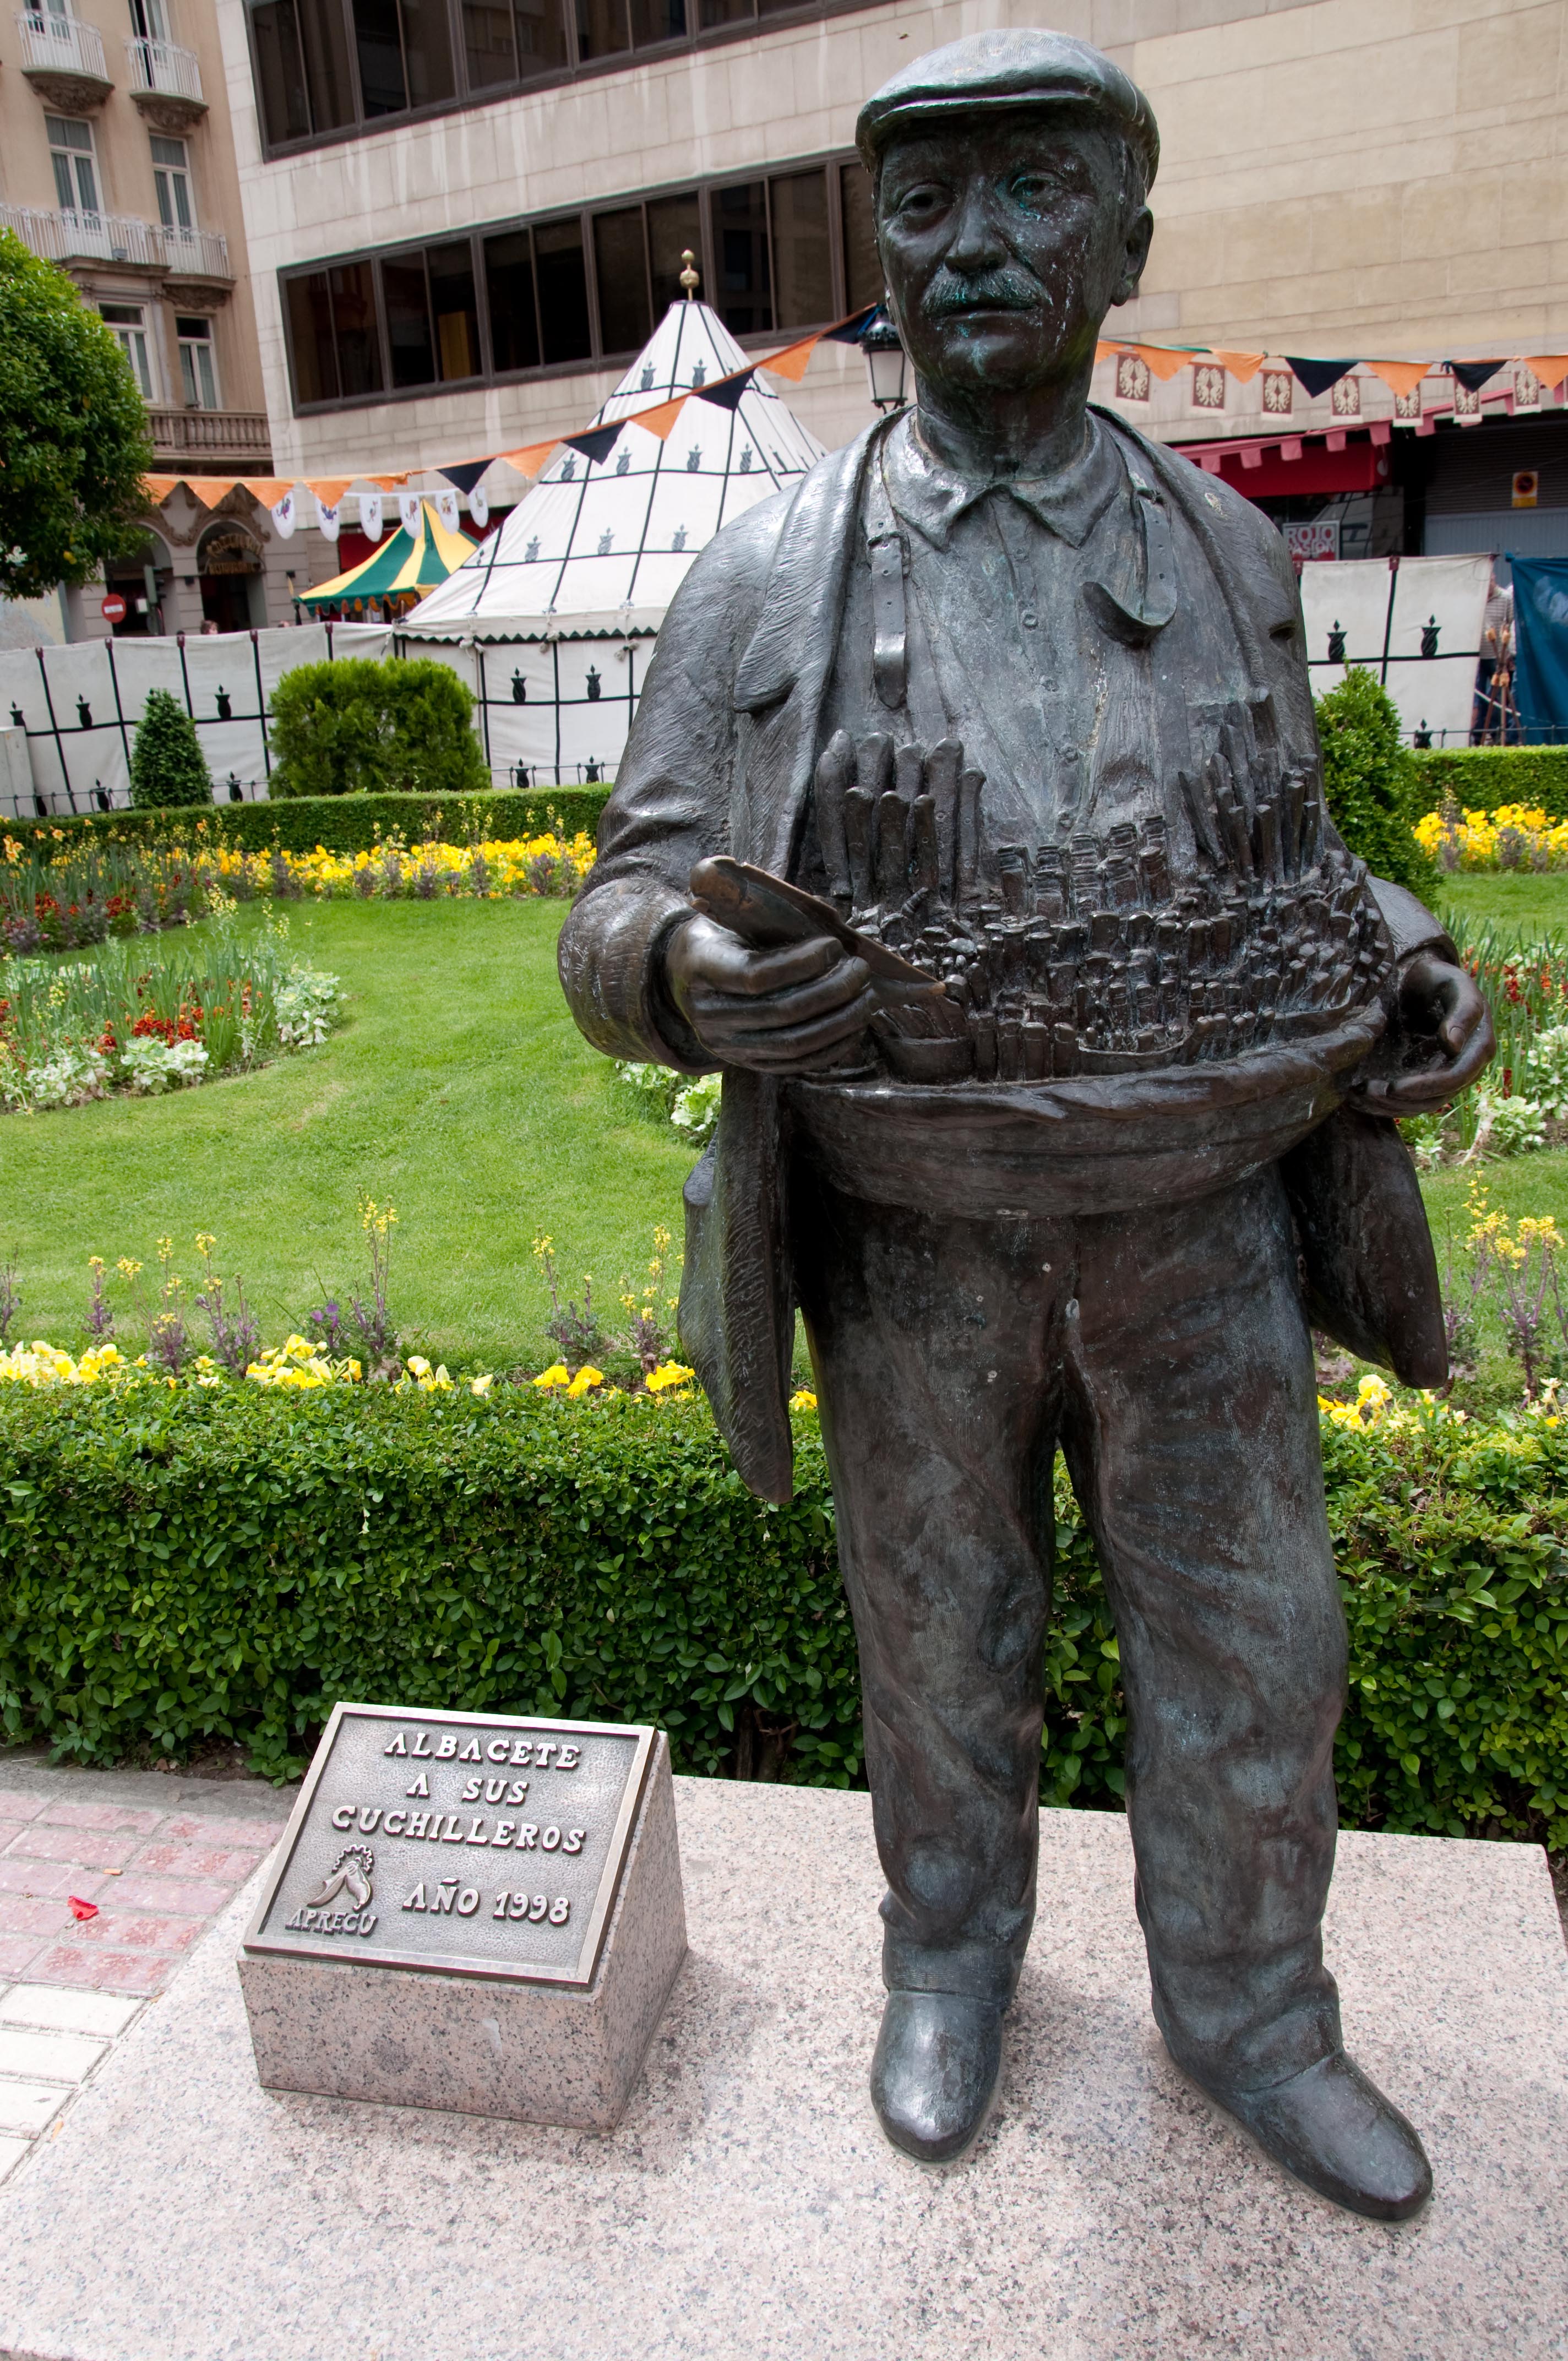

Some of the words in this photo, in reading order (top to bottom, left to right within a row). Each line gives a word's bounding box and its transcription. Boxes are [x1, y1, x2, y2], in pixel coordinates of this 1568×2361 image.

[1286, 526, 1335, 543] ROJO
[385, 1732, 580, 1769] ALBACETE
[406, 1772, 430, 1798] A
[461, 1777, 528, 1805] SUS
[331, 1805, 585, 1854] CUCHILLEROS
[402, 1877, 480, 1915] AÑO
[493, 1891, 570, 1925] 1998
[285, 1908, 378, 1936] APRECU
